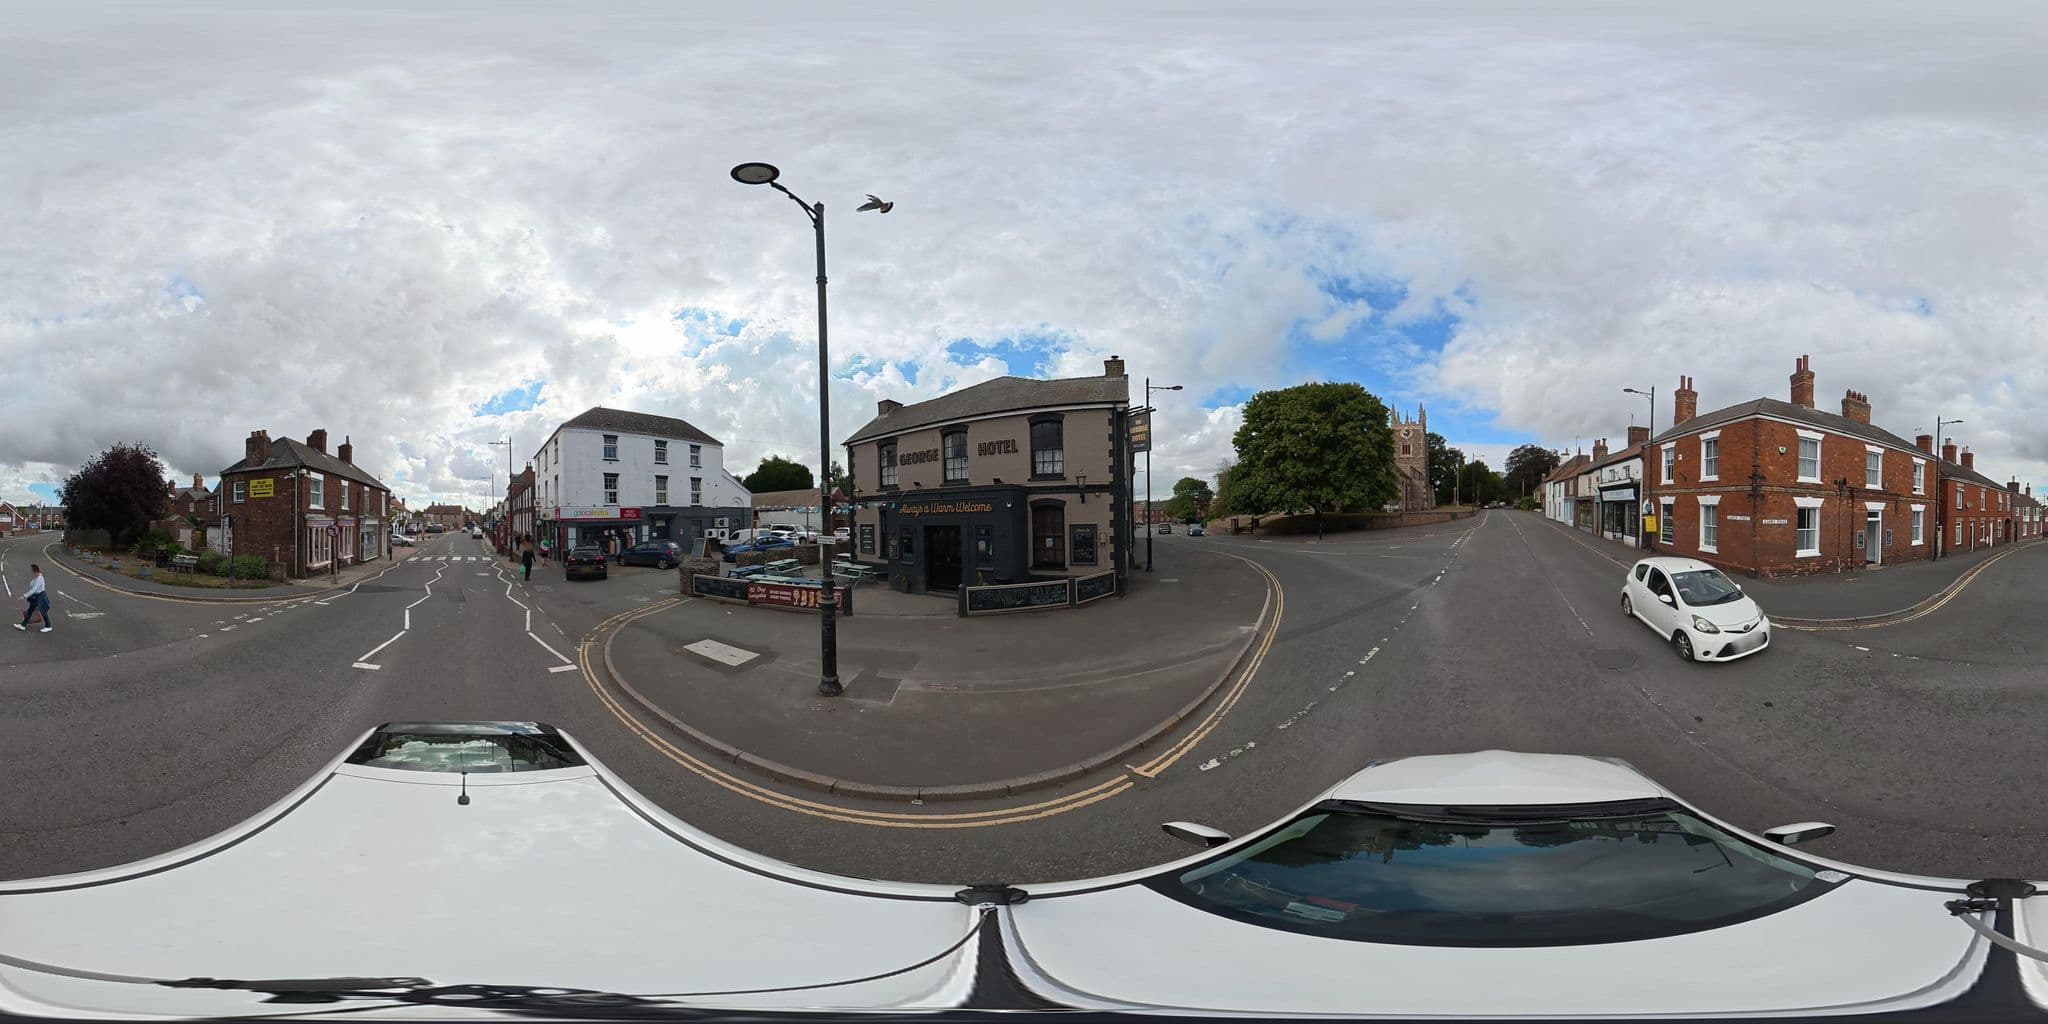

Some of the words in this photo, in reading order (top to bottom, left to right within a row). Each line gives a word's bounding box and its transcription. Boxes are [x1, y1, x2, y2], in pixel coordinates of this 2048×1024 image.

[899, 448, 939, 466] GEORGE
[978, 439, 1018, 456] HOTEL
[899, 503, 923, 517] Always
[930, 503, 955, 513] Warm
[955, 501, 992, 513] Welcome
